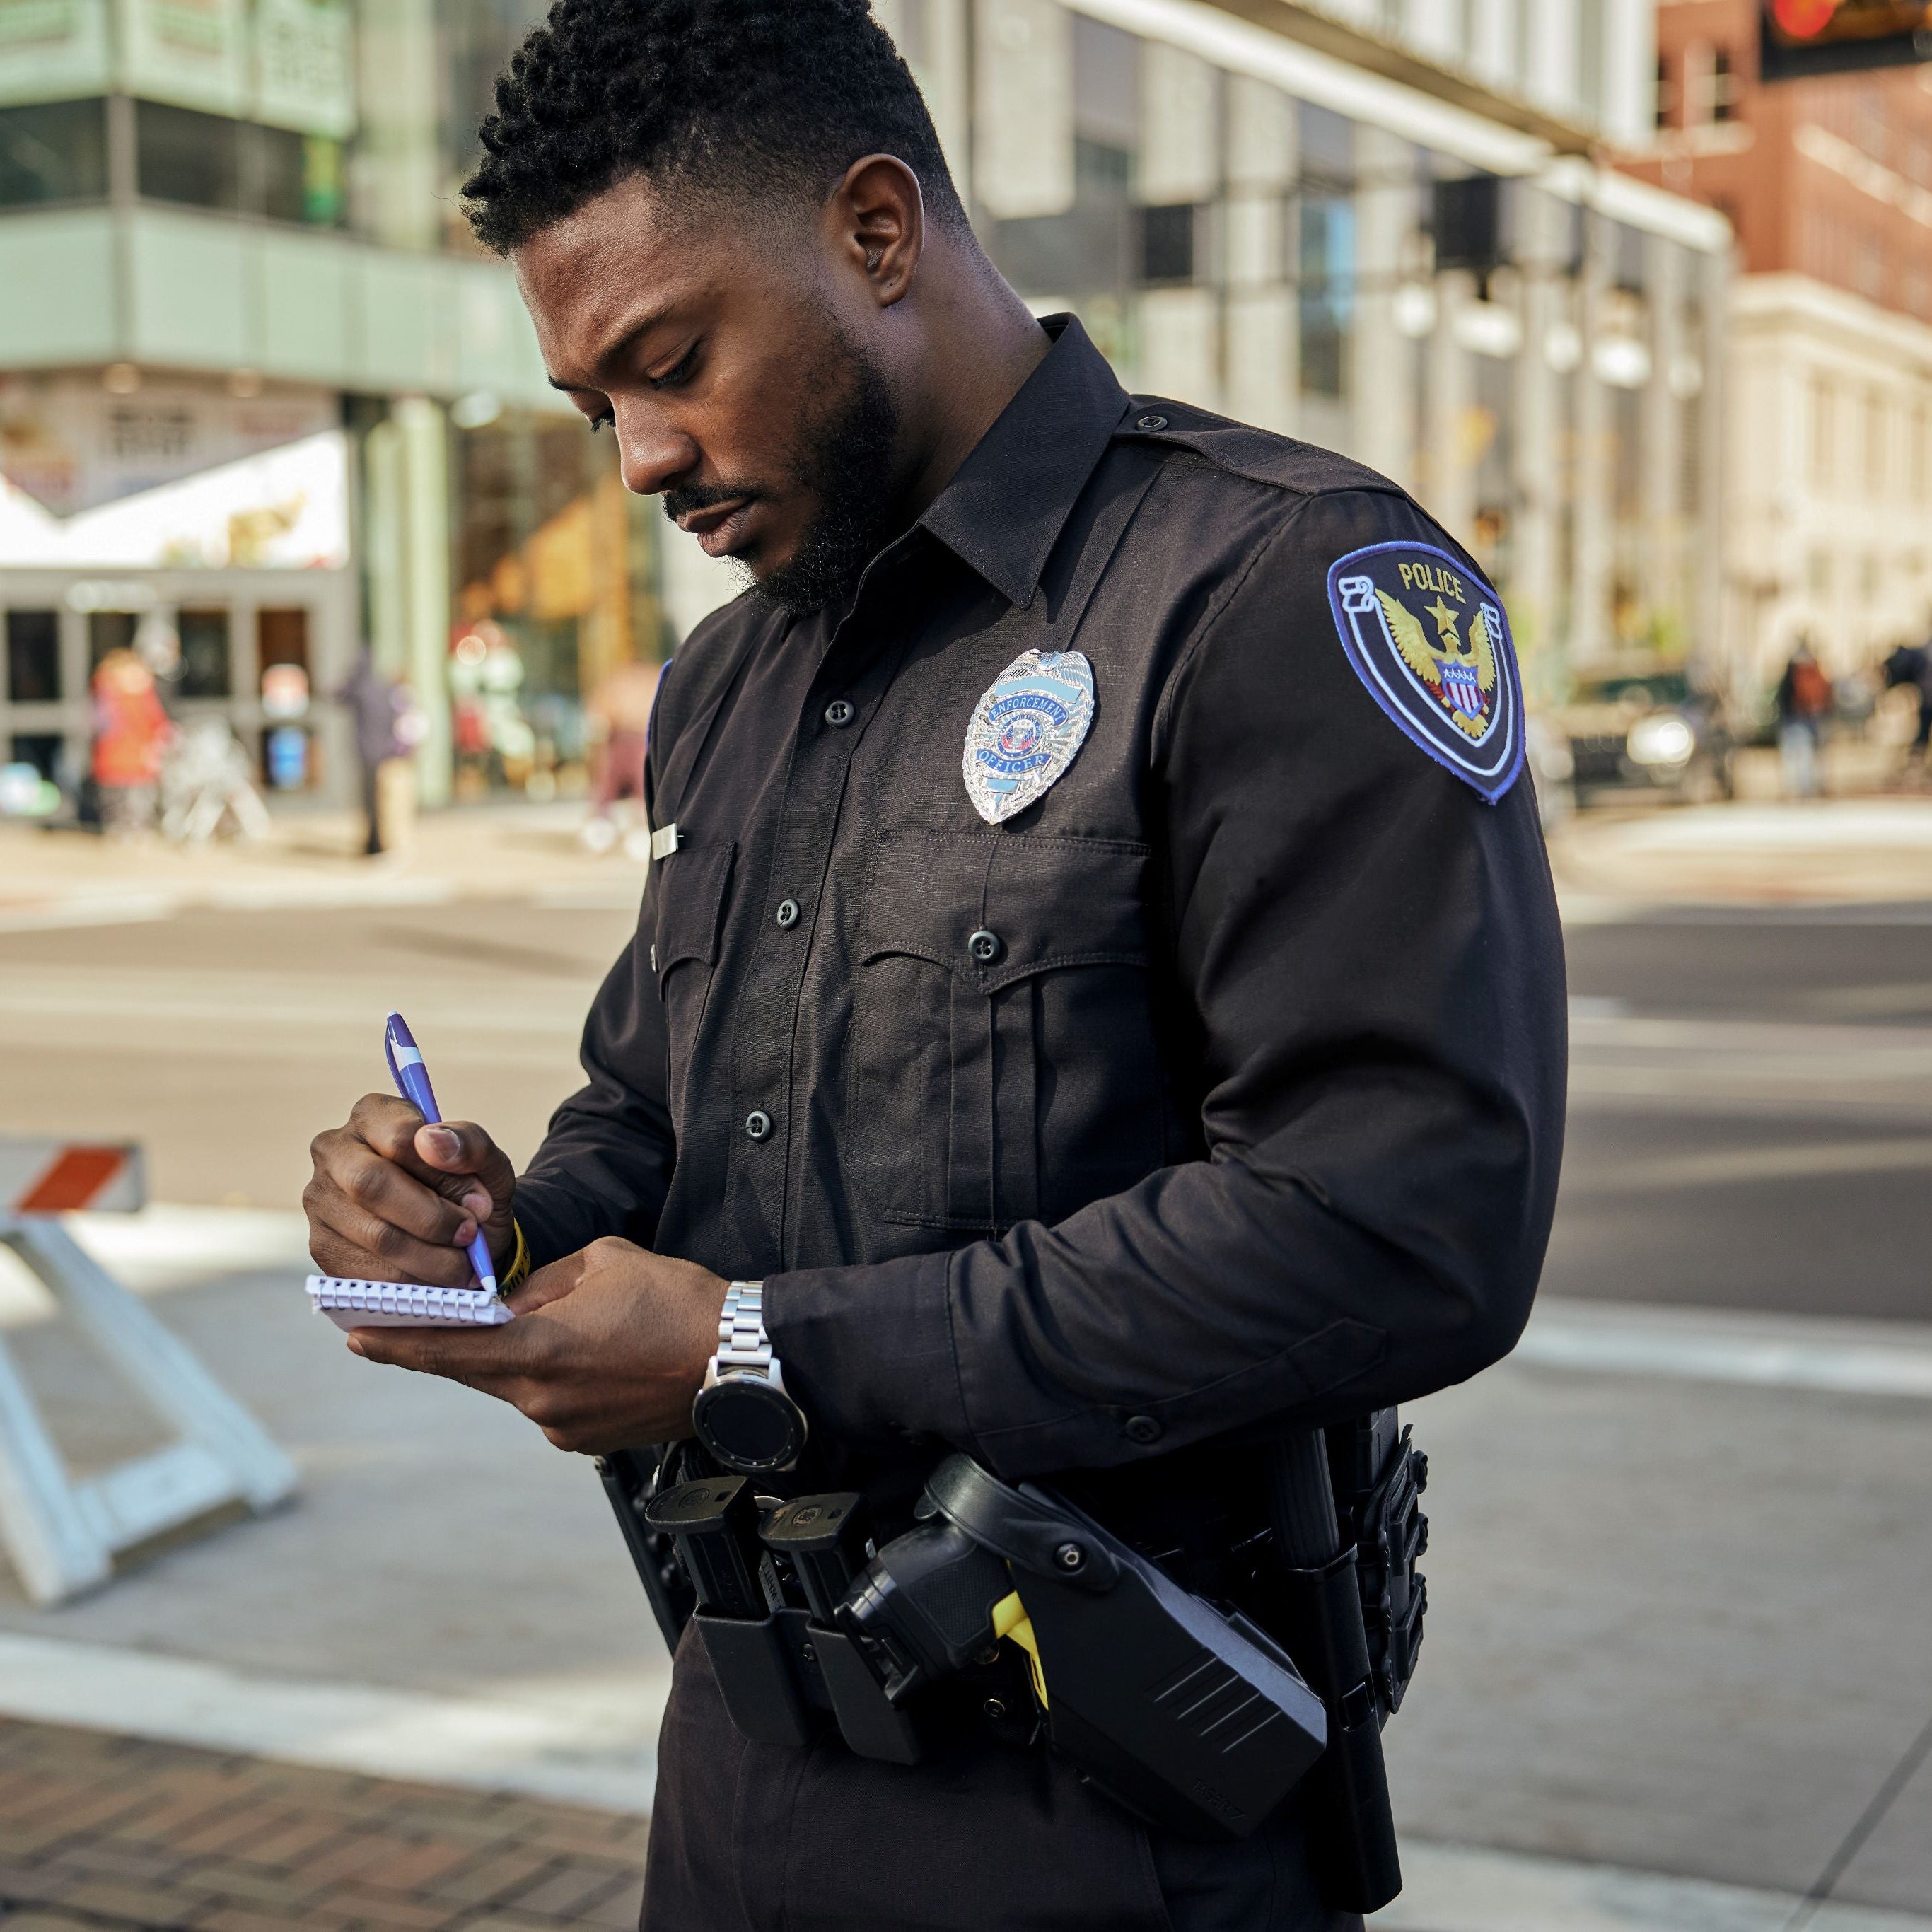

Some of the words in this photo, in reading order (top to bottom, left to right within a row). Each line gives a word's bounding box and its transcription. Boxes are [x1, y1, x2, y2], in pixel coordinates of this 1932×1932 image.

[1397, 562, 1467, 605] POLICE
[991, 697, 1066, 721] ENFORCEMENT
[979, 750, 1044, 772] OFFICER
[1193, 1776, 1233, 1812] TASER
[1229, 1807, 1245, 1820] 7
